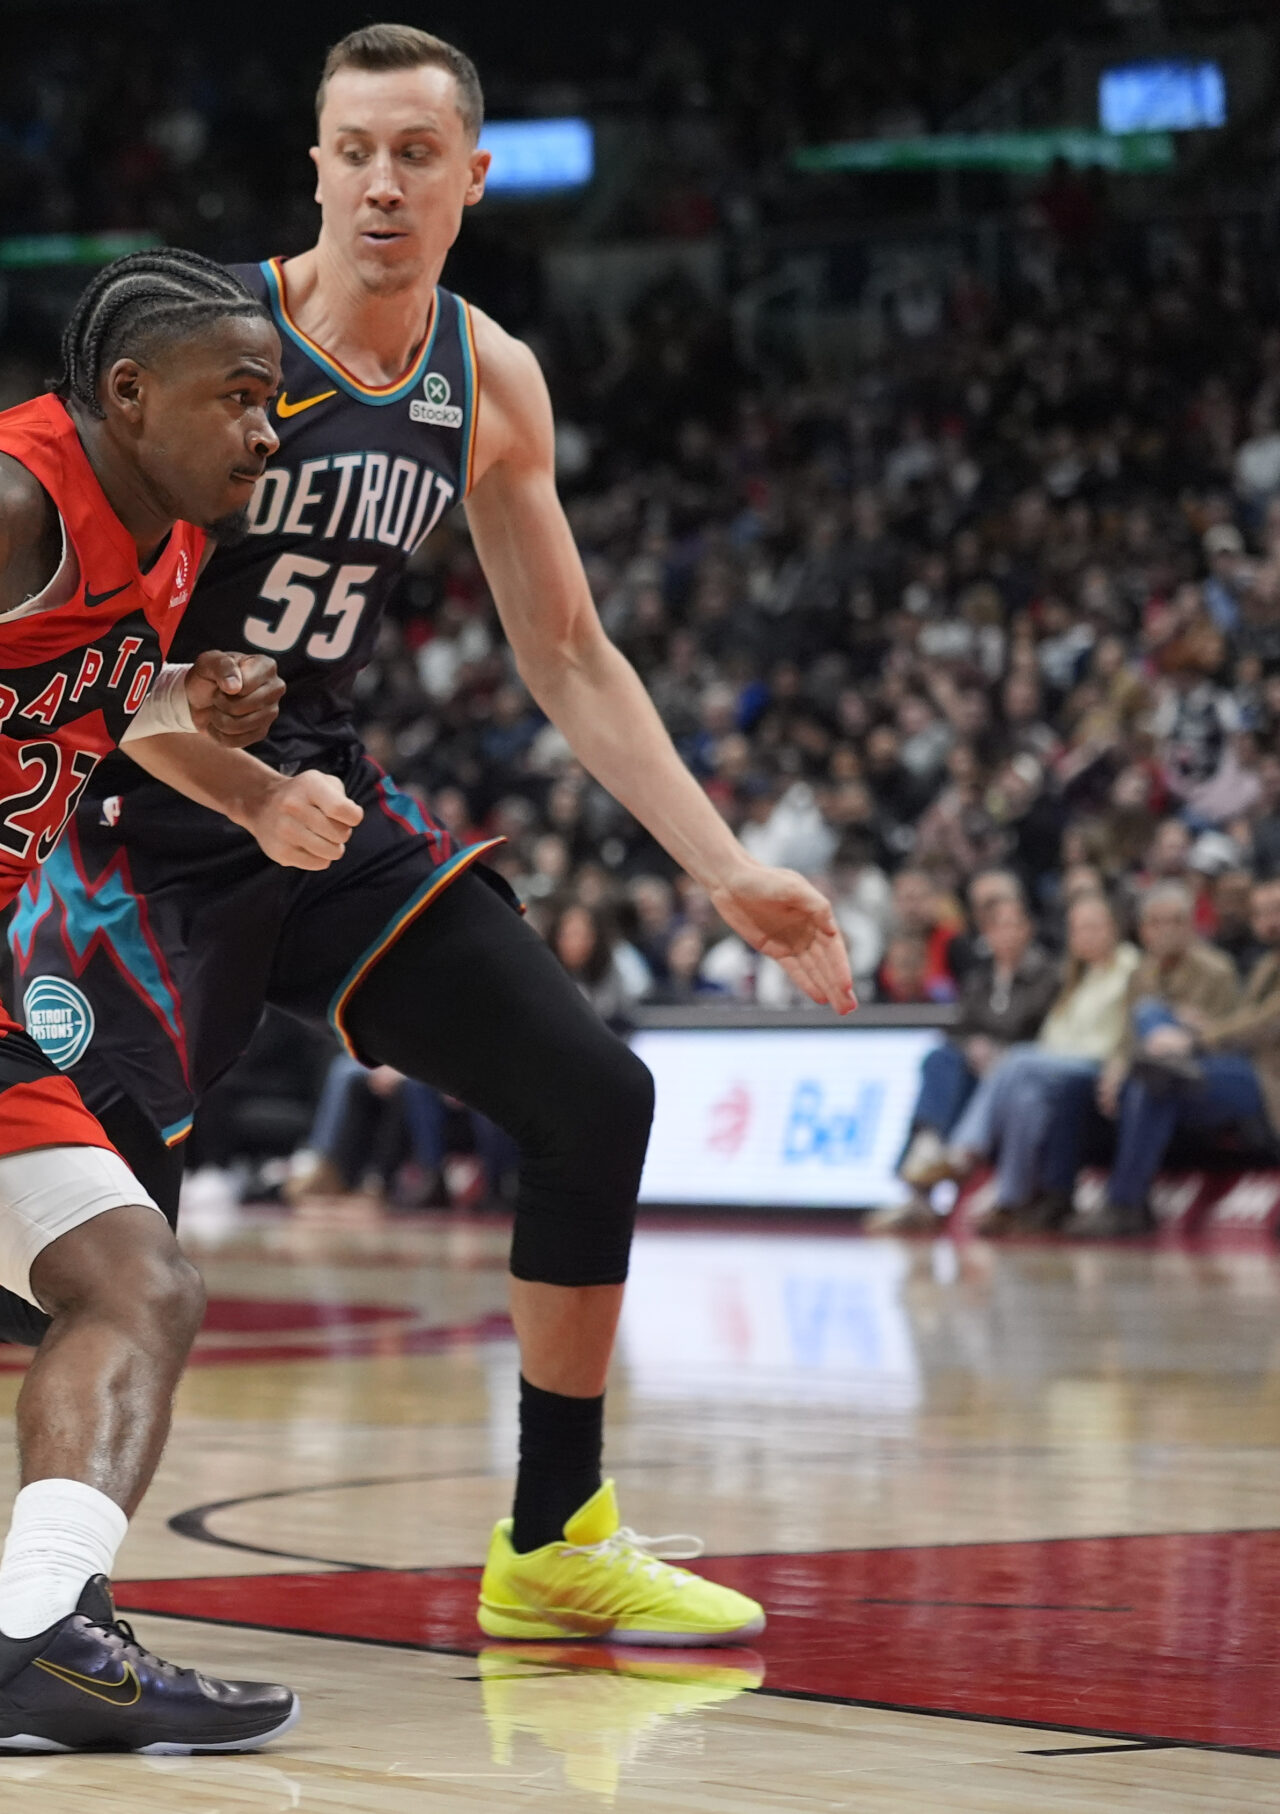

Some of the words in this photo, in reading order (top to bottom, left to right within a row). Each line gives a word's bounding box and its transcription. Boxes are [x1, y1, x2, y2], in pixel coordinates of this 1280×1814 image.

[412, 404, 459, 424] StockX
[247, 453, 454, 556] DETROIT
[243, 553, 379, 661] 55
[31, 1008, 74, 1026] DETROIT
[31, 1023, 75, 1040] PISTONS
